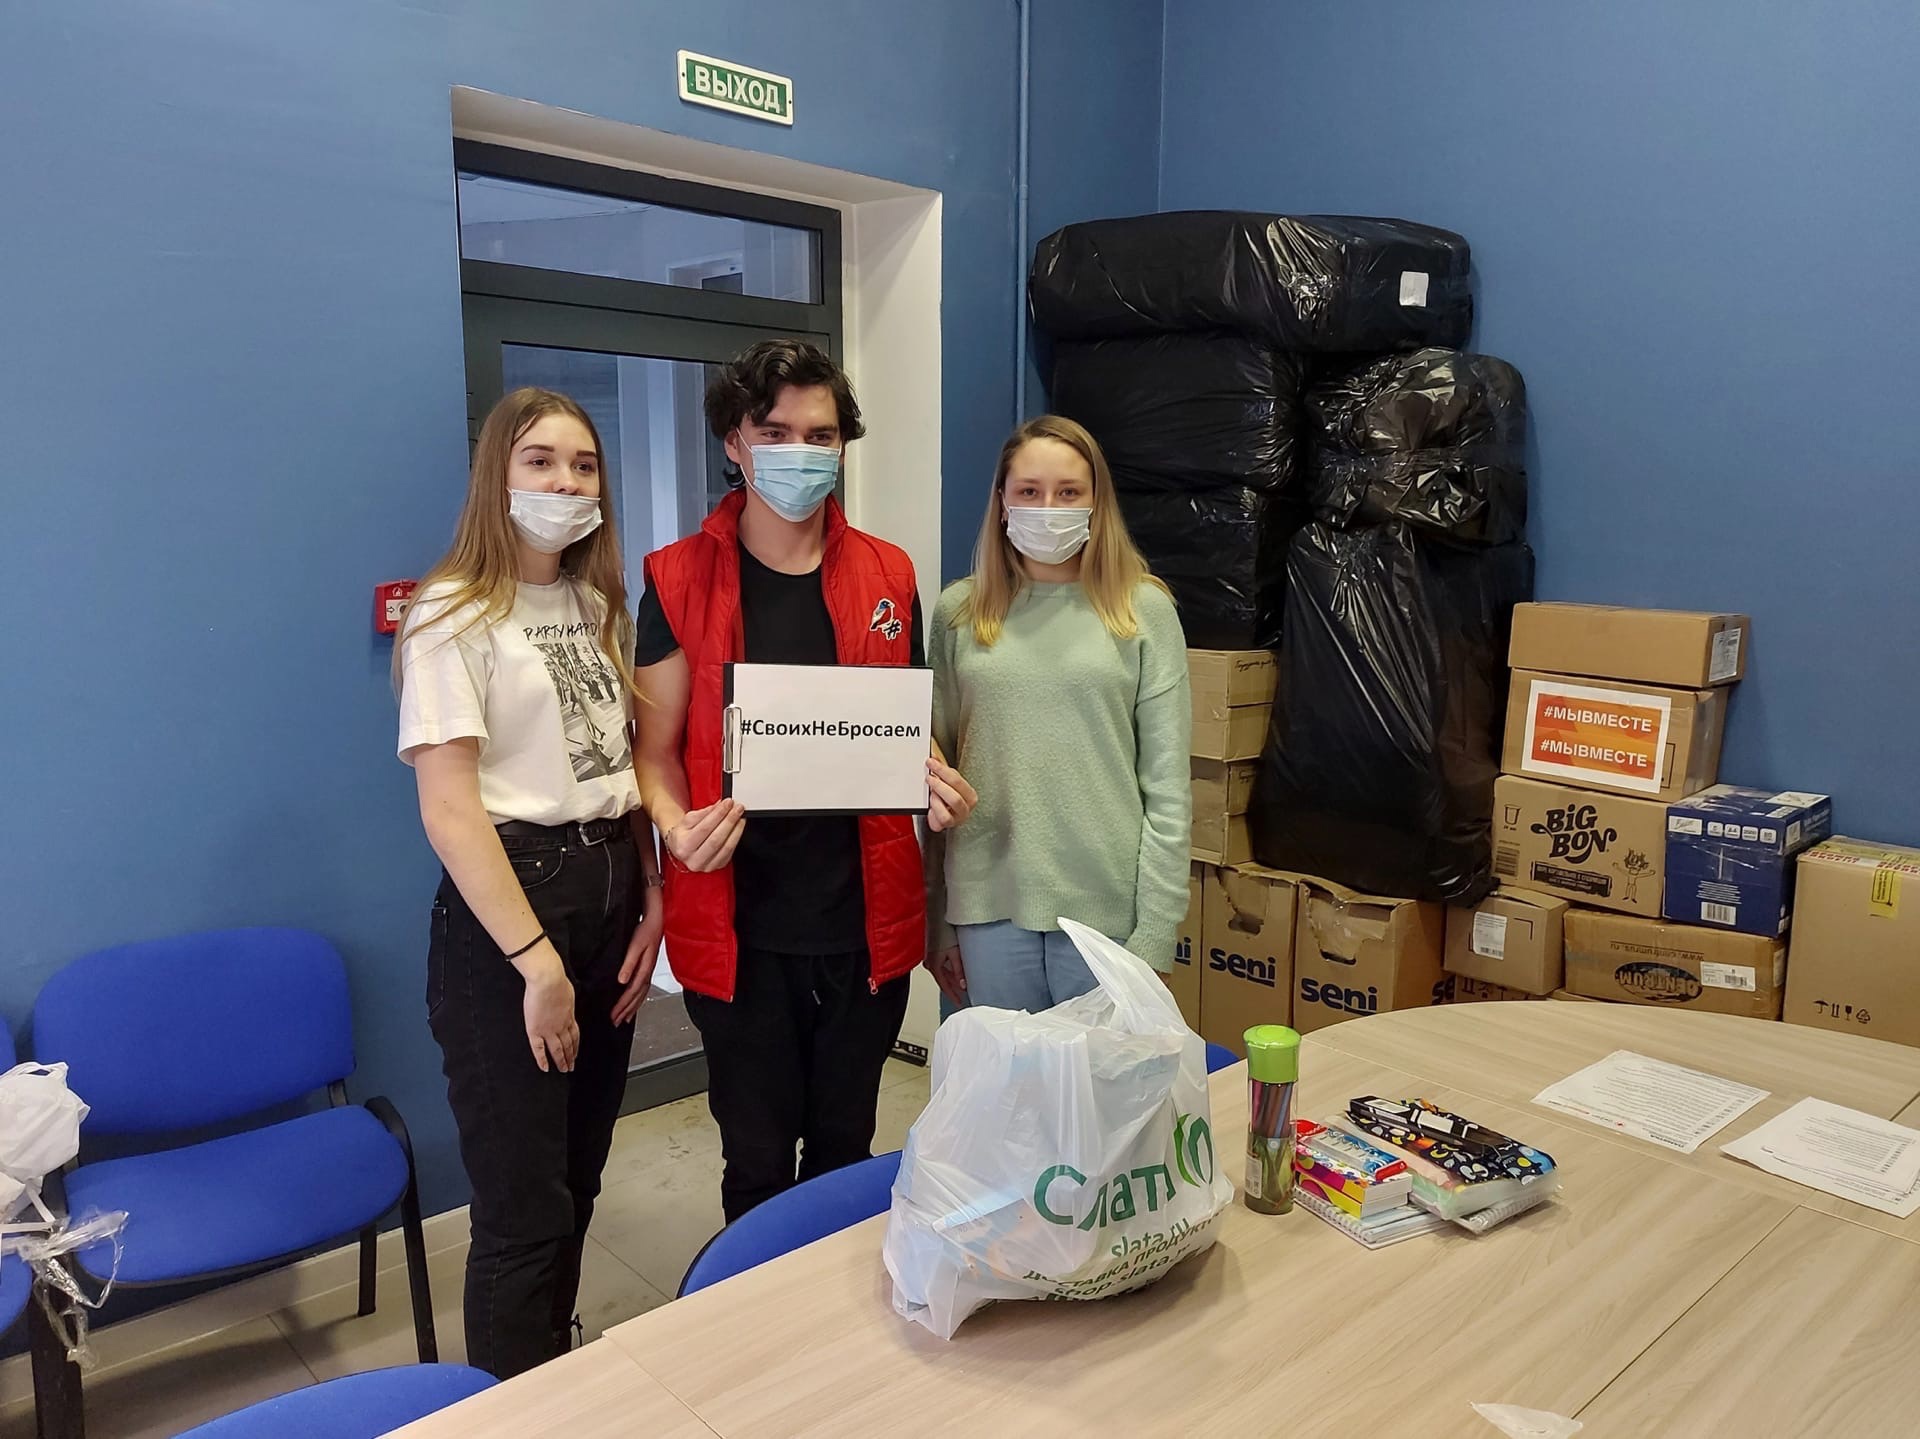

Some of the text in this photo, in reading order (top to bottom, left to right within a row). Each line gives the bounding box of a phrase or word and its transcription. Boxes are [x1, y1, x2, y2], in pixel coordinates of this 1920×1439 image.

[693, 64, 781, 113] ВЫХОД
[523, 624, 565, 641] PARTY
[741, 719, 921, 740] #СвоихНеБросаем
[1543, 705, 1652, 732] #МЫВМЕСТЕ
[1540, 738, 1648, 767] #МЫВМЕСТЕ
[1536, 825, 1617, 864] BON
[1209, 948, 1276, 988] seni
[1301, 977, 1377, 1016] seni
[1111, 1217, 1191, 1258] slataru
